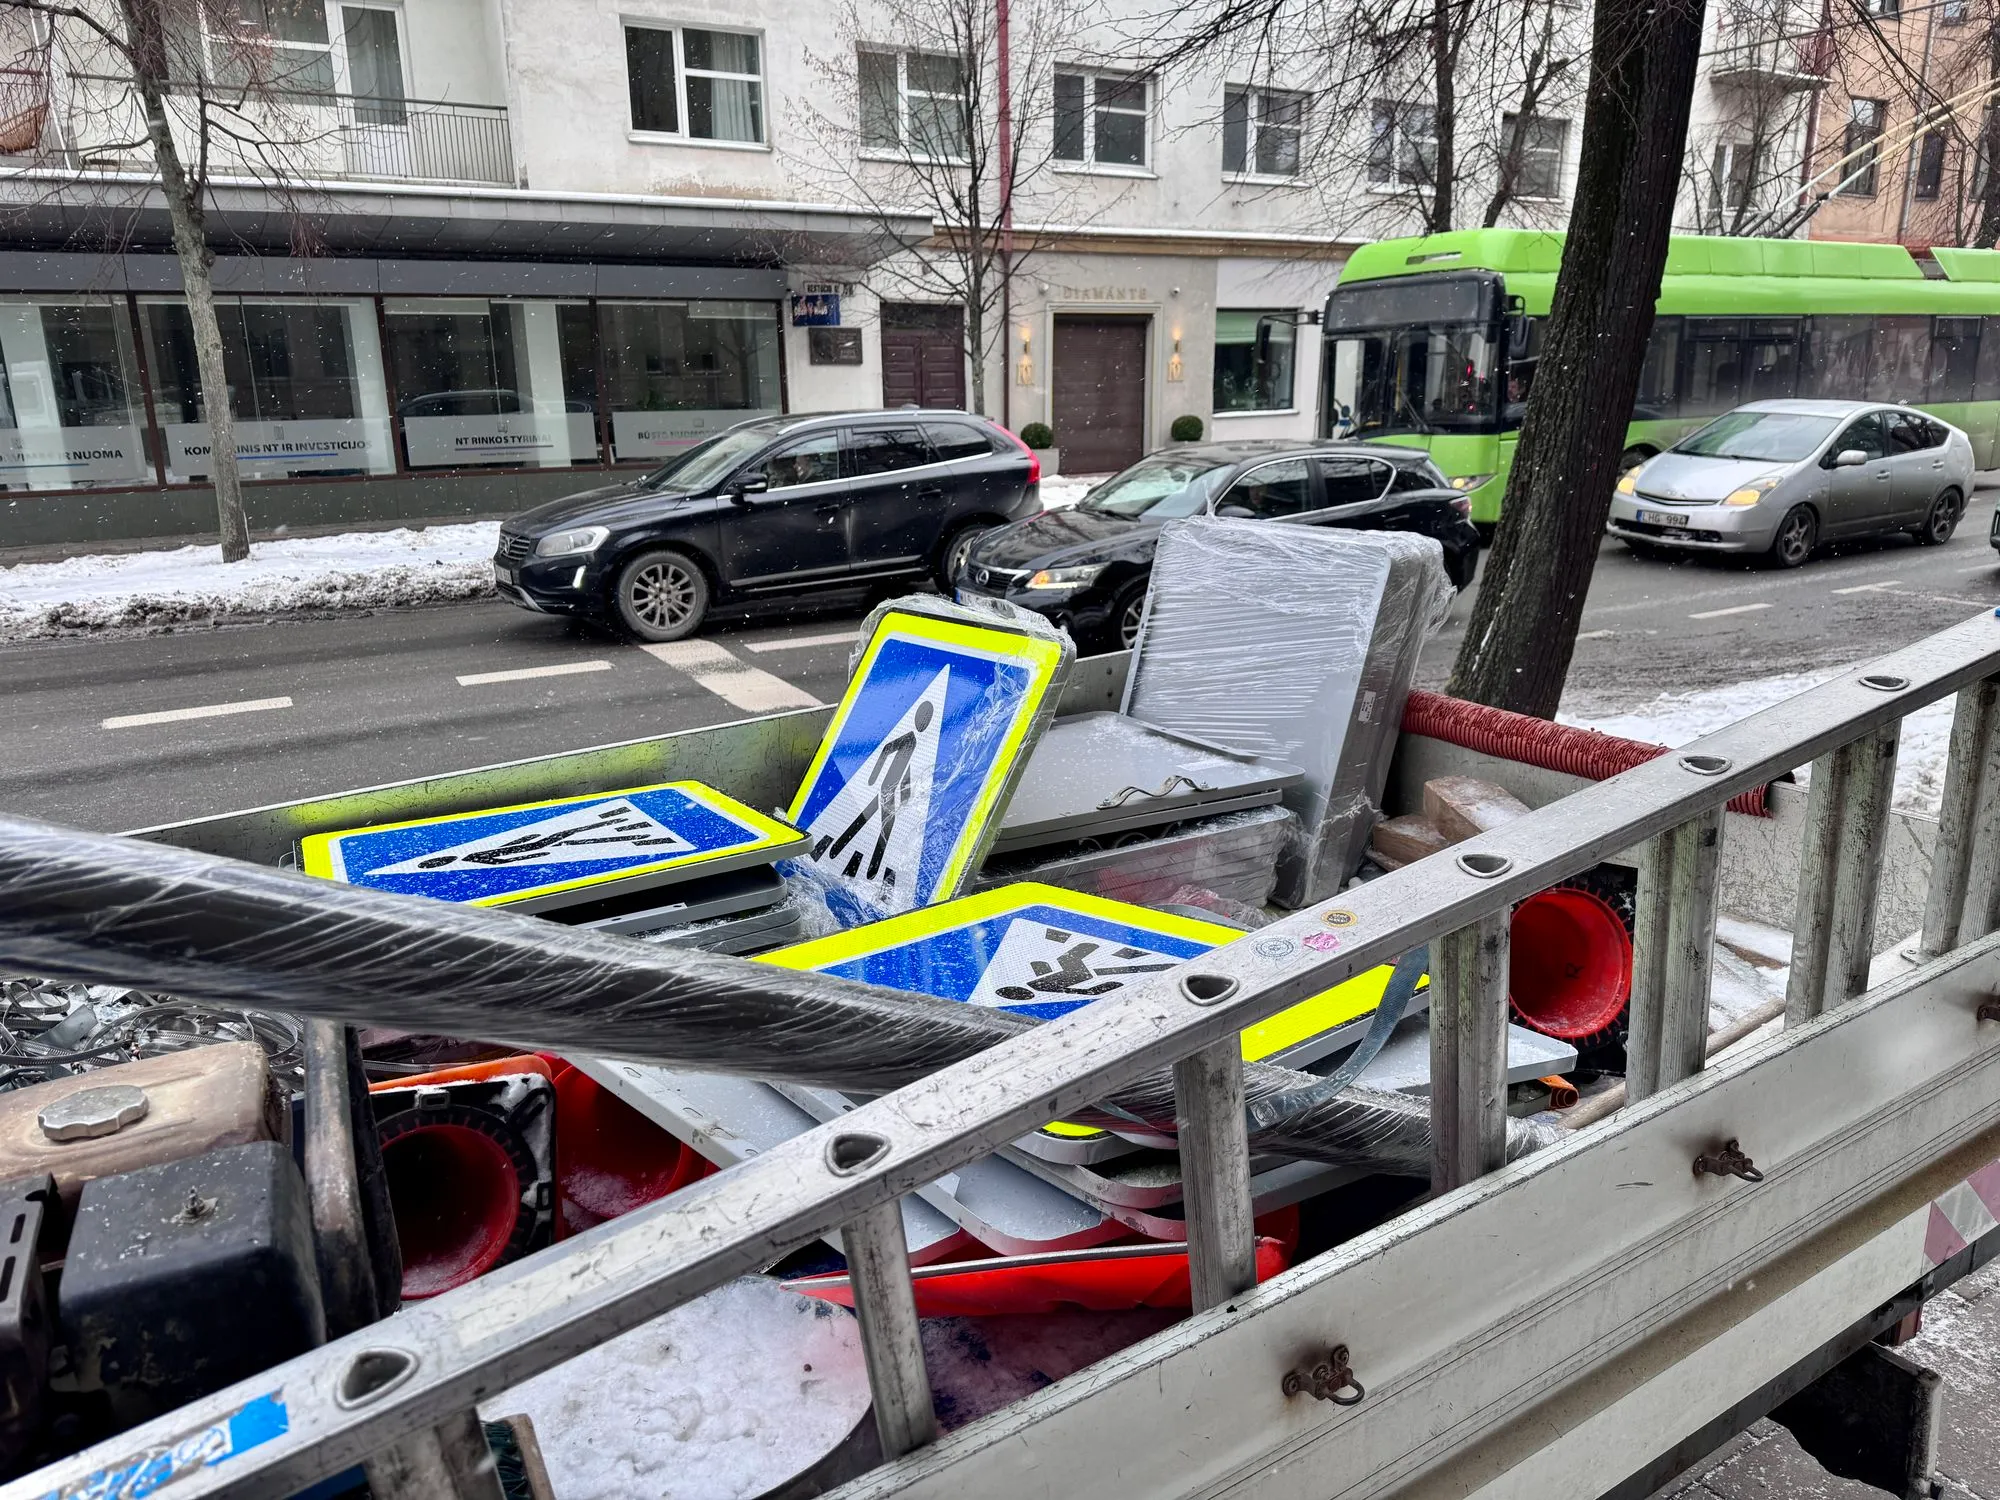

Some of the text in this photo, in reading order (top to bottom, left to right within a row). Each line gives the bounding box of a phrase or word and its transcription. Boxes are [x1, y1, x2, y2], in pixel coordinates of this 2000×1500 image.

[455, 436, 470, 446] NT
[471, 435, 509, 445] RINKOS
[262, 443, 280, 453] NT
[281, 442, 294, 452] IR
[73, 448, 123, 461] NUOMA
